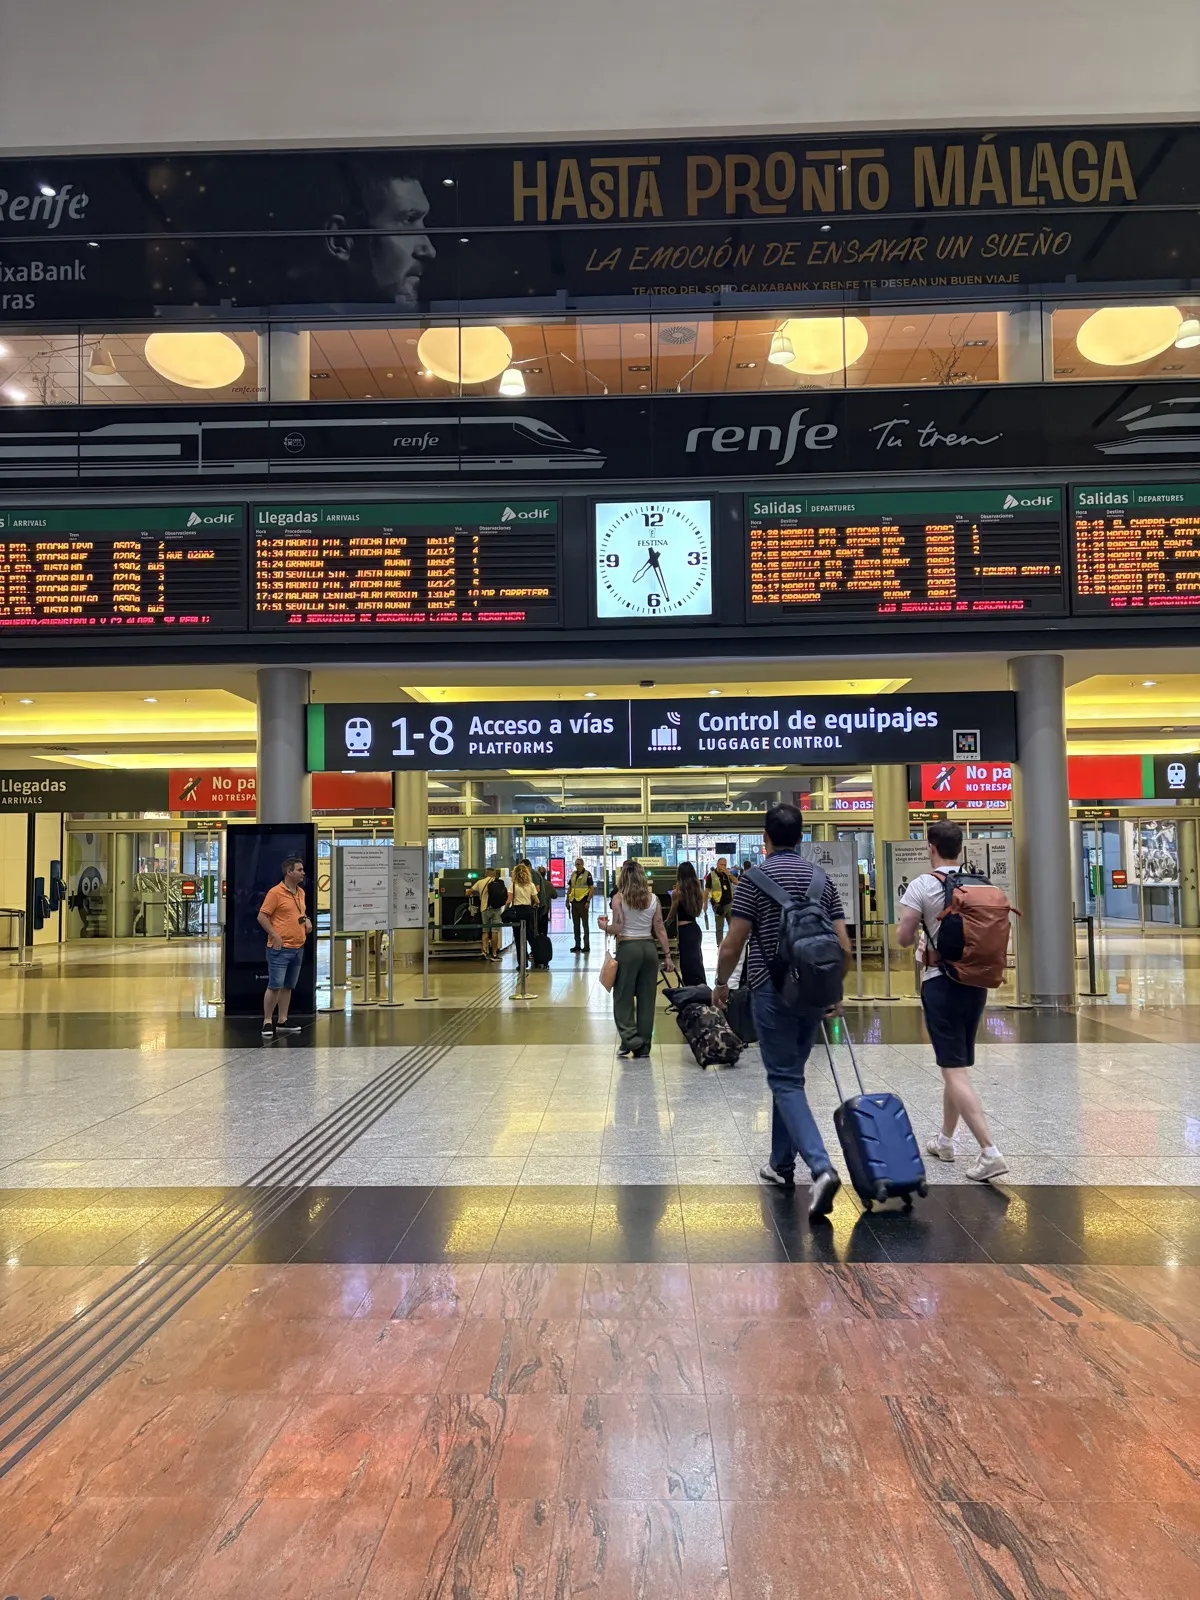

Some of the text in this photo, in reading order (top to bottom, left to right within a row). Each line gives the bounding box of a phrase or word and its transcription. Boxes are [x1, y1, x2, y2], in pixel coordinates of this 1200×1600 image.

[513, 133, 1137, 222] HASTA PRONTO MÁLAGA
[586, 226, 1072, 271] LA EMOCIÓN DE ENSAYAR UN SUEÑO
[632, 273, 1020, 296] TEATRO DEL SOHO CAIXABANK Y RENFE TE DESEAN UN BUEN VIAJE
[393, 432, 440, 451] renfe
[685, 407, 838, 466] renfe
[868, 418, 910, 450] Tu
[754, 495, 1053, 515] Salidas DEPARTURES adif
[1079, 492, 1184, 505] Salidas DEPARTURES
[13, 513, 235, 527] ARRIVALS adif
[258, 508, 550, 526] Llegadas ARRIVALS adif
[642, 513, 664, 527] 12
[256, 539, 284, 547] 14:29
[256, 549, 284, 557] 14:34
[606, 552, 701, 568] 9 3
[256, 560, 284, 568] 15:24
[256, 571, 284, 579] 15:30
[256, 581, 284, 589] 15:35
[256, 592, 284, 600] 17:42
[647, 593, 661, 607] 6
[256, 602, 284, 611] 17:51
[698, 706, 938, 733] Control de equipajes
[391, 713, 614, 756] 1-8 Acceso a vías
[469, 741, 554, 754] PLATFORMS
[698, 735, 842, 751] LUGGAGE CONTROL
[966, 765, 987, 779] No
[1, 778, 67, 795] Llegadas
[212, 776, 232, 790] No
[966, 783, 979, 791] NO
[1, 796, 43, 805] ARRIVALS
[835, 799, 849, 809] No
